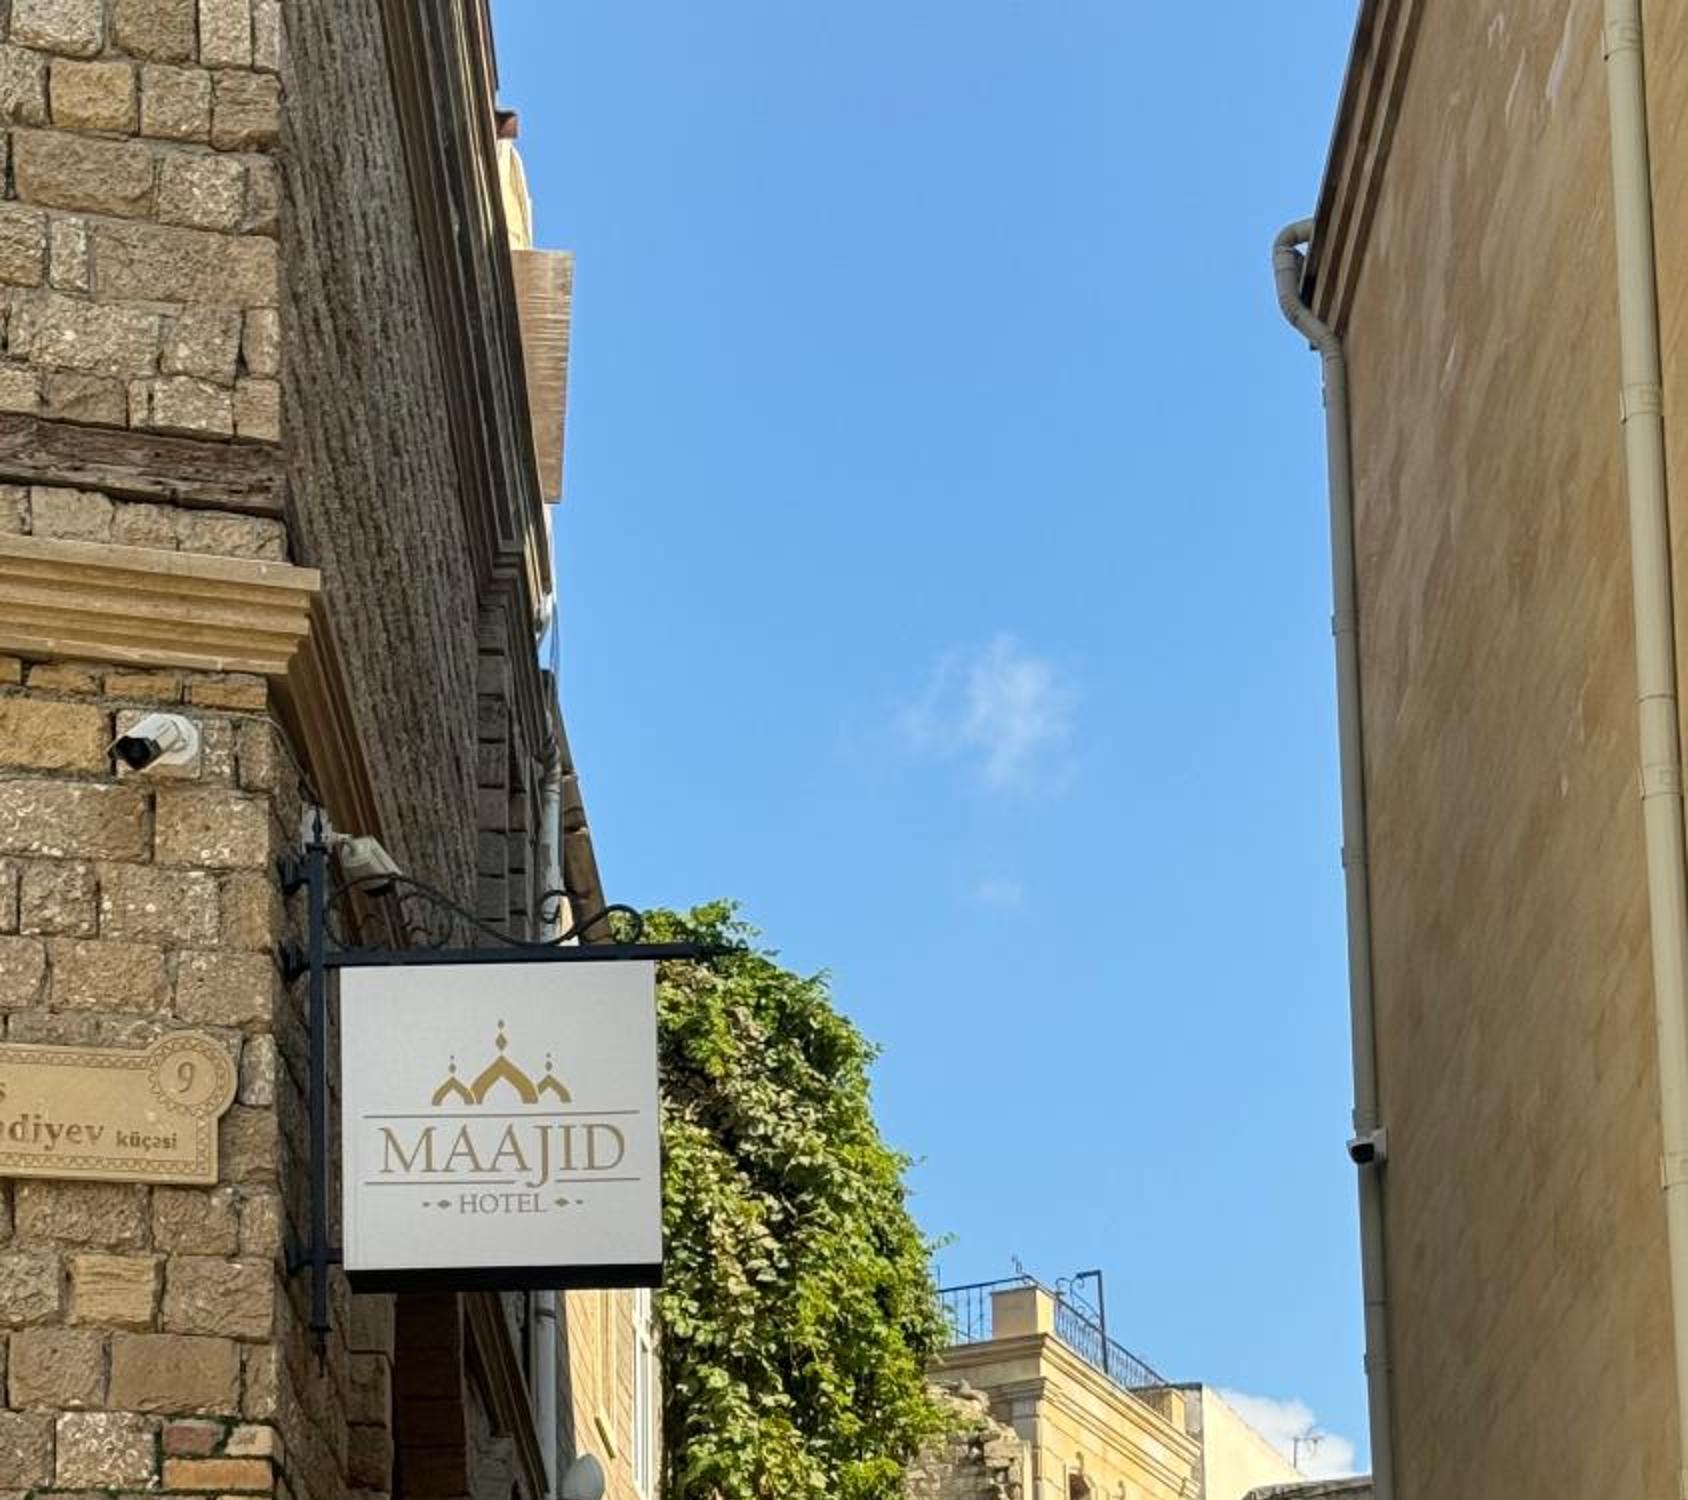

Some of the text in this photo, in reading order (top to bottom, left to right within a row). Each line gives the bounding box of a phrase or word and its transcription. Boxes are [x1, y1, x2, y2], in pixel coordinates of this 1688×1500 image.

[177, 1061, 196, 1093] 9
[0, 1114, 177, 1151] diyev küçəsi
[377, 1123, 625, 1188] MAAJID
[459, 1193, 548, 1214] HOTEL
